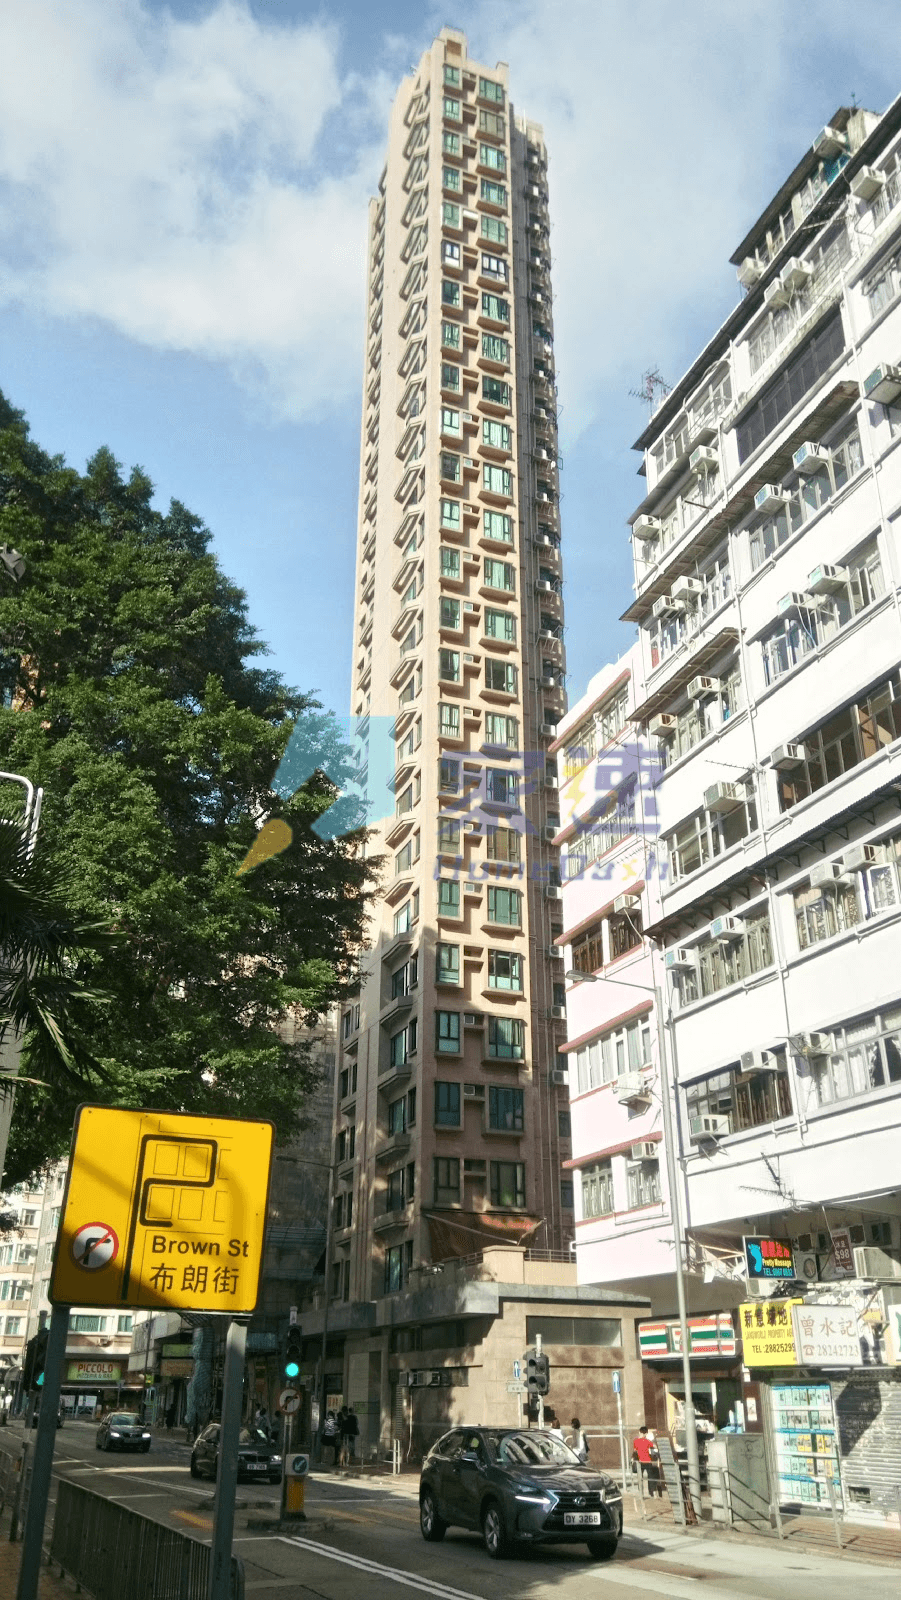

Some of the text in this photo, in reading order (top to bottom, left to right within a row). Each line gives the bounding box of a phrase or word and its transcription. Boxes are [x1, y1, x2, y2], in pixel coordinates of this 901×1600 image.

[152, 1235, 249, 1257] Brown St
[835, 1248, 850, 1260] $98
[150, 1263, 239, 1295] 布朗街
[800, 1315, 856, 1338] 曾水記
[817, 1344, 859, 1357] 28242723
[78, 1363, 113, 1373] PICCOLO
[565, 1515, 576, 1523] DY
